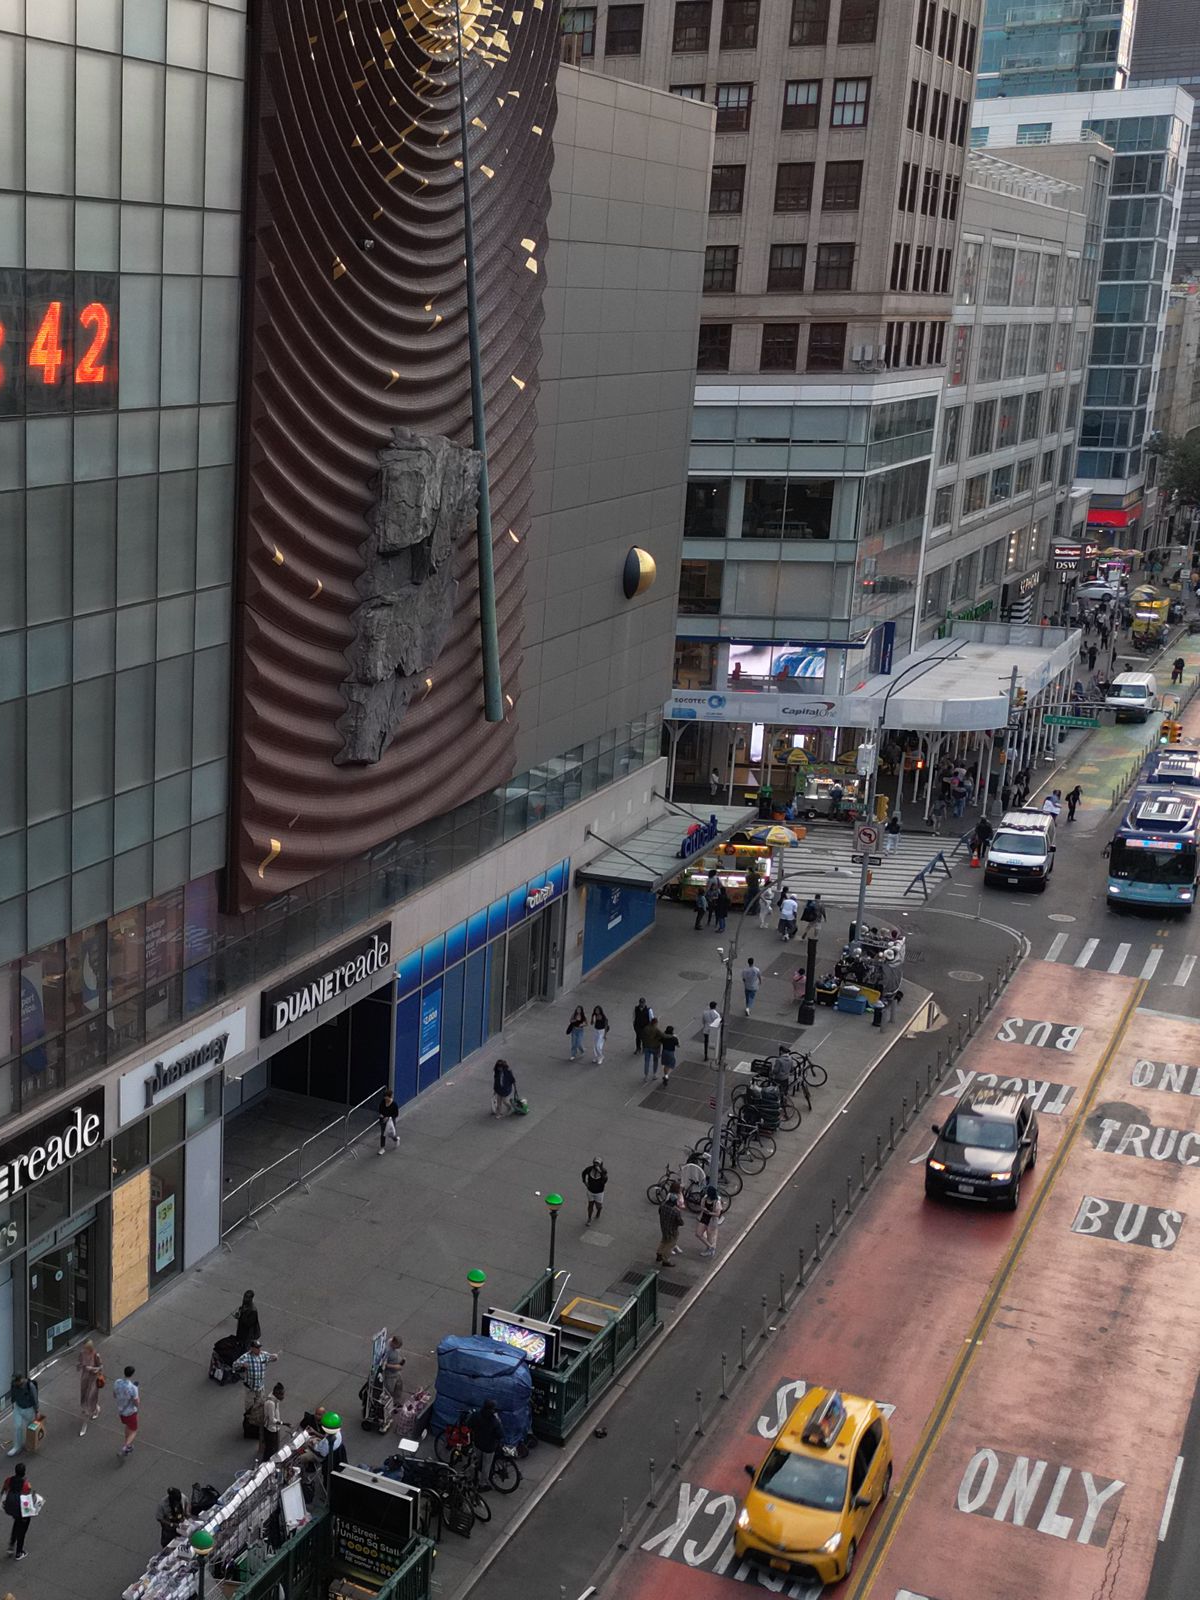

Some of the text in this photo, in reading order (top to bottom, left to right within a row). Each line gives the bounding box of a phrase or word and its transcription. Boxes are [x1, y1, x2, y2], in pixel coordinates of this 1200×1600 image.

[1055, 561, 1078, 570] DSW
[996, 1017, 1085, 1052] BUS
[1073, 1195, 1182, 1249] BUS
[957, 1448, 1126, 1545] ONLY
[340, 1528, 365, 1544] Union
[366, 1538, 379, 1550] Sq
[341, 1521, 350, 1531] 14
